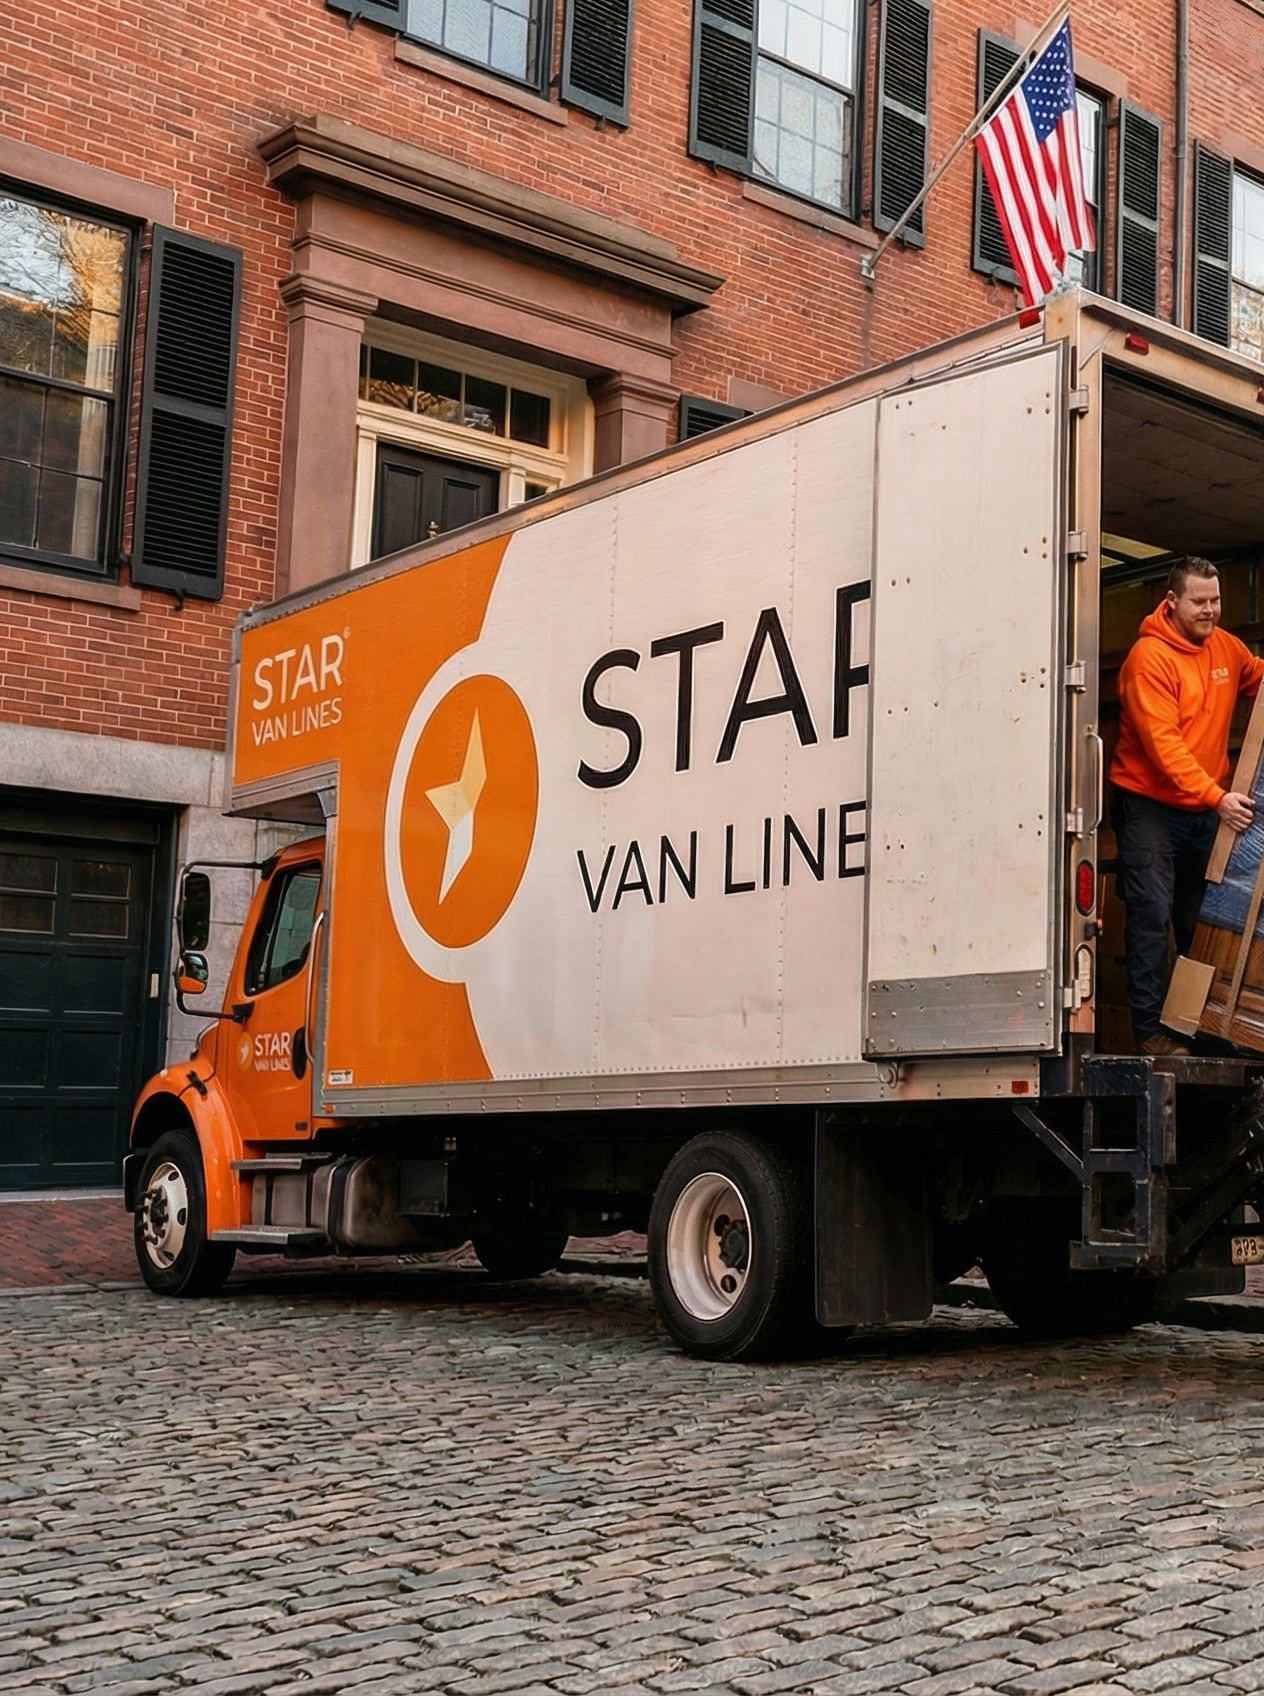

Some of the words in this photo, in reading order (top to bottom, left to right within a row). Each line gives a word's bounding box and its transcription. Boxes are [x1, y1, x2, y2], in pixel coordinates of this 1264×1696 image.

[252, 634, 343, 711] STAR
[252, 713, 287, 747] VAN
[291, 697, 342, 736] LINES
[576, 830, 698, 913] VAN
[254, 1031, 292, 1057] STAR
